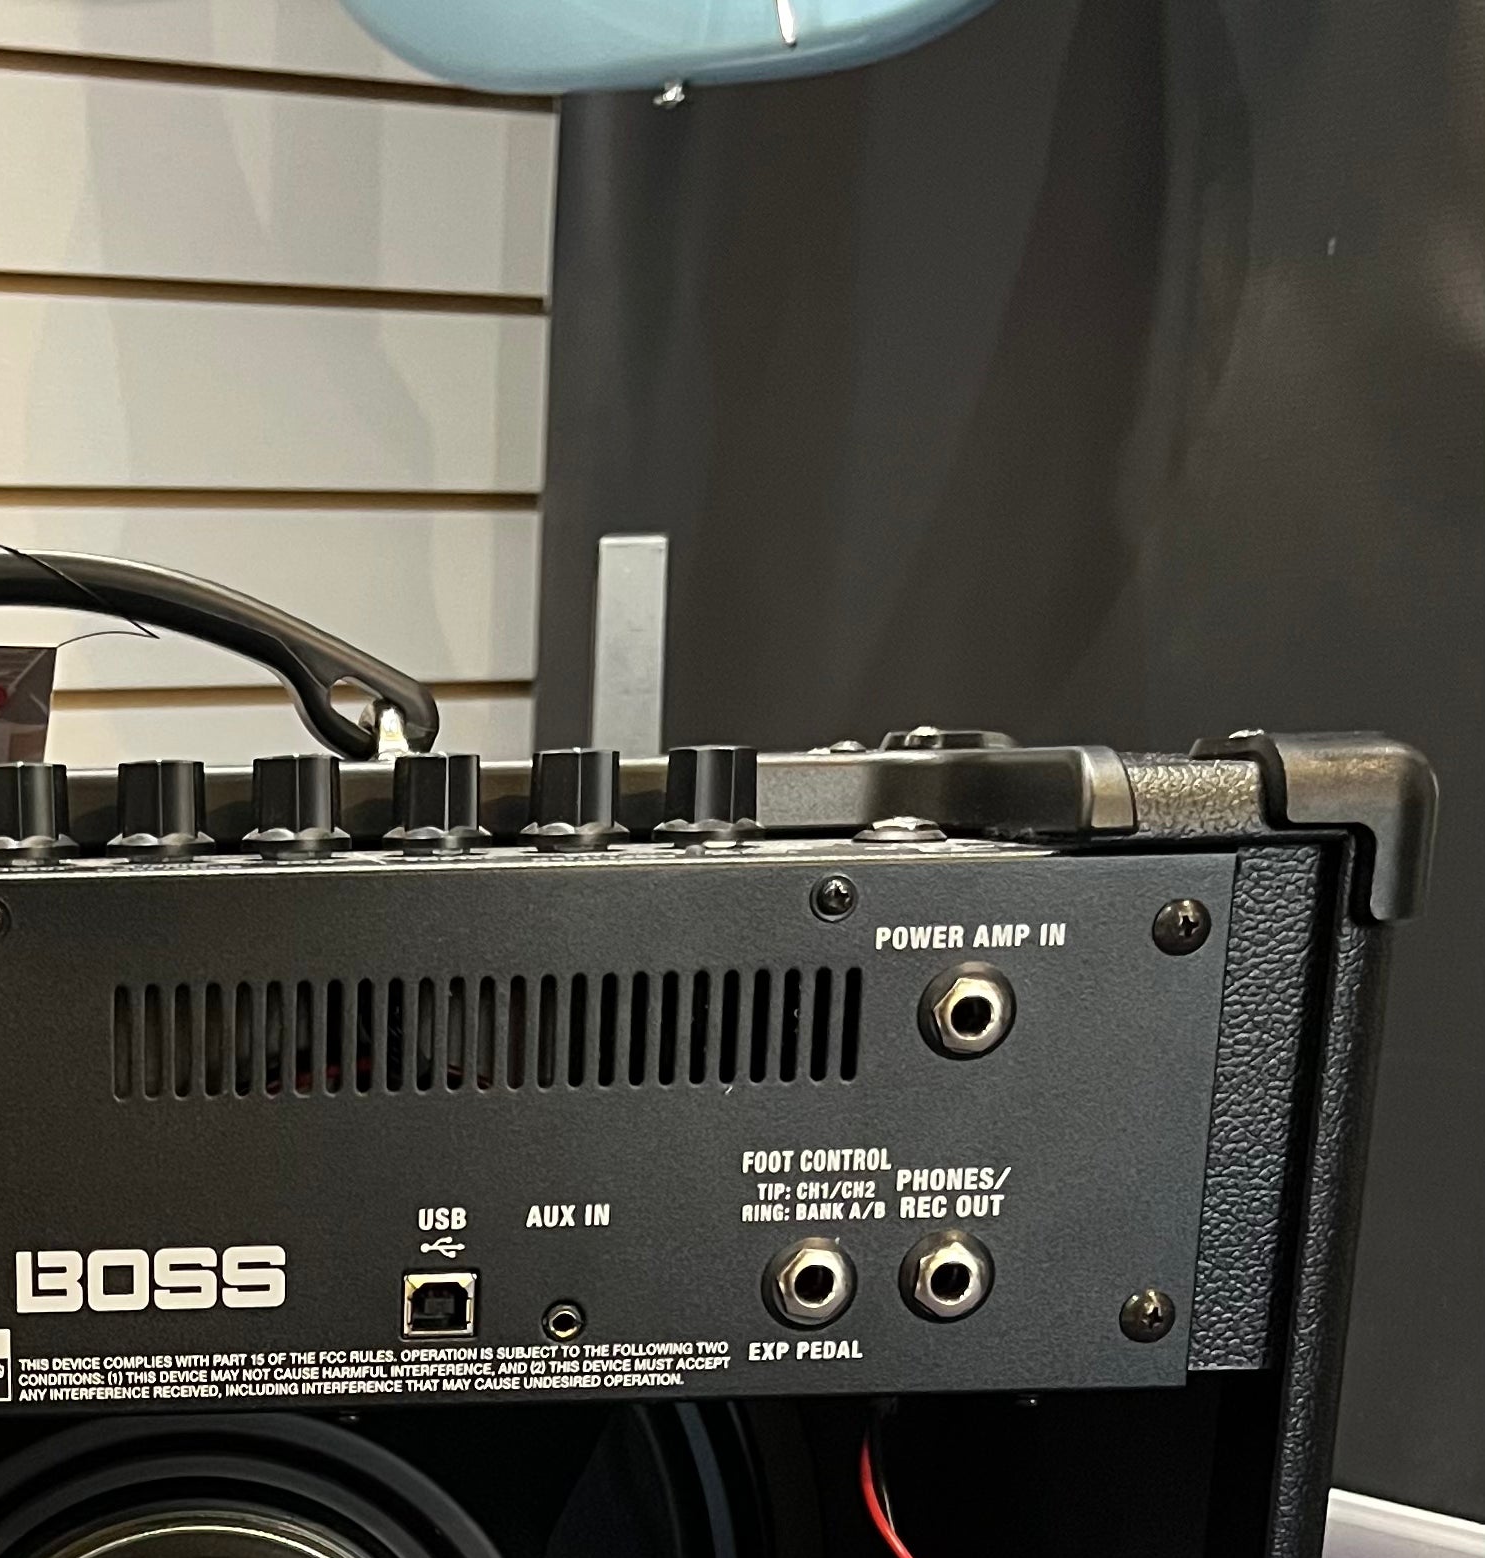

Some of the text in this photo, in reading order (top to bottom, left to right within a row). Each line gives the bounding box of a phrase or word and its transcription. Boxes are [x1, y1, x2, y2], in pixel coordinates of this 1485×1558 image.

[875, 924, 1066, 950] POWER AMP IN
[741, 1148, 891, 1174] FOOT CONTROL
[757, 1181, 876, 1201] TIP: CH1/CH2
[897, 1167, 1011, 1192] PHONES/
[526, 1204, 610, 1228] AUX IN
[741, 1201, 885, 1222] RING: BANK A/B
[899, 1194, 1004, 1218] REC OUT
[418, 1208, 467, 1231] USB
[16, 1244, 287, 1313] BOSS
[19, 1342, 728, 1371] THIS DEVICE COMPLIES WITH PART 15 OF THE FCC RULES. OPERATION IS SUBJECT TO THE FOLLOWING TWO
[749, 1340, 863, 1361] EXP PEDAL
[19, 1356, 731, 1386] CONDITIONS: (1) THIS DEVICE MAY NOT CAUSE HARMFUL INTERFERENCE, AND (2) THIS DEVICE MUST ACCEPT
[19, 1373, 684, 1401] ANY INTERFERENCE RECEIVED, INCLUDING INTERFERENCE THAT MAY CAUSE UNDESIRED OPERATION.
